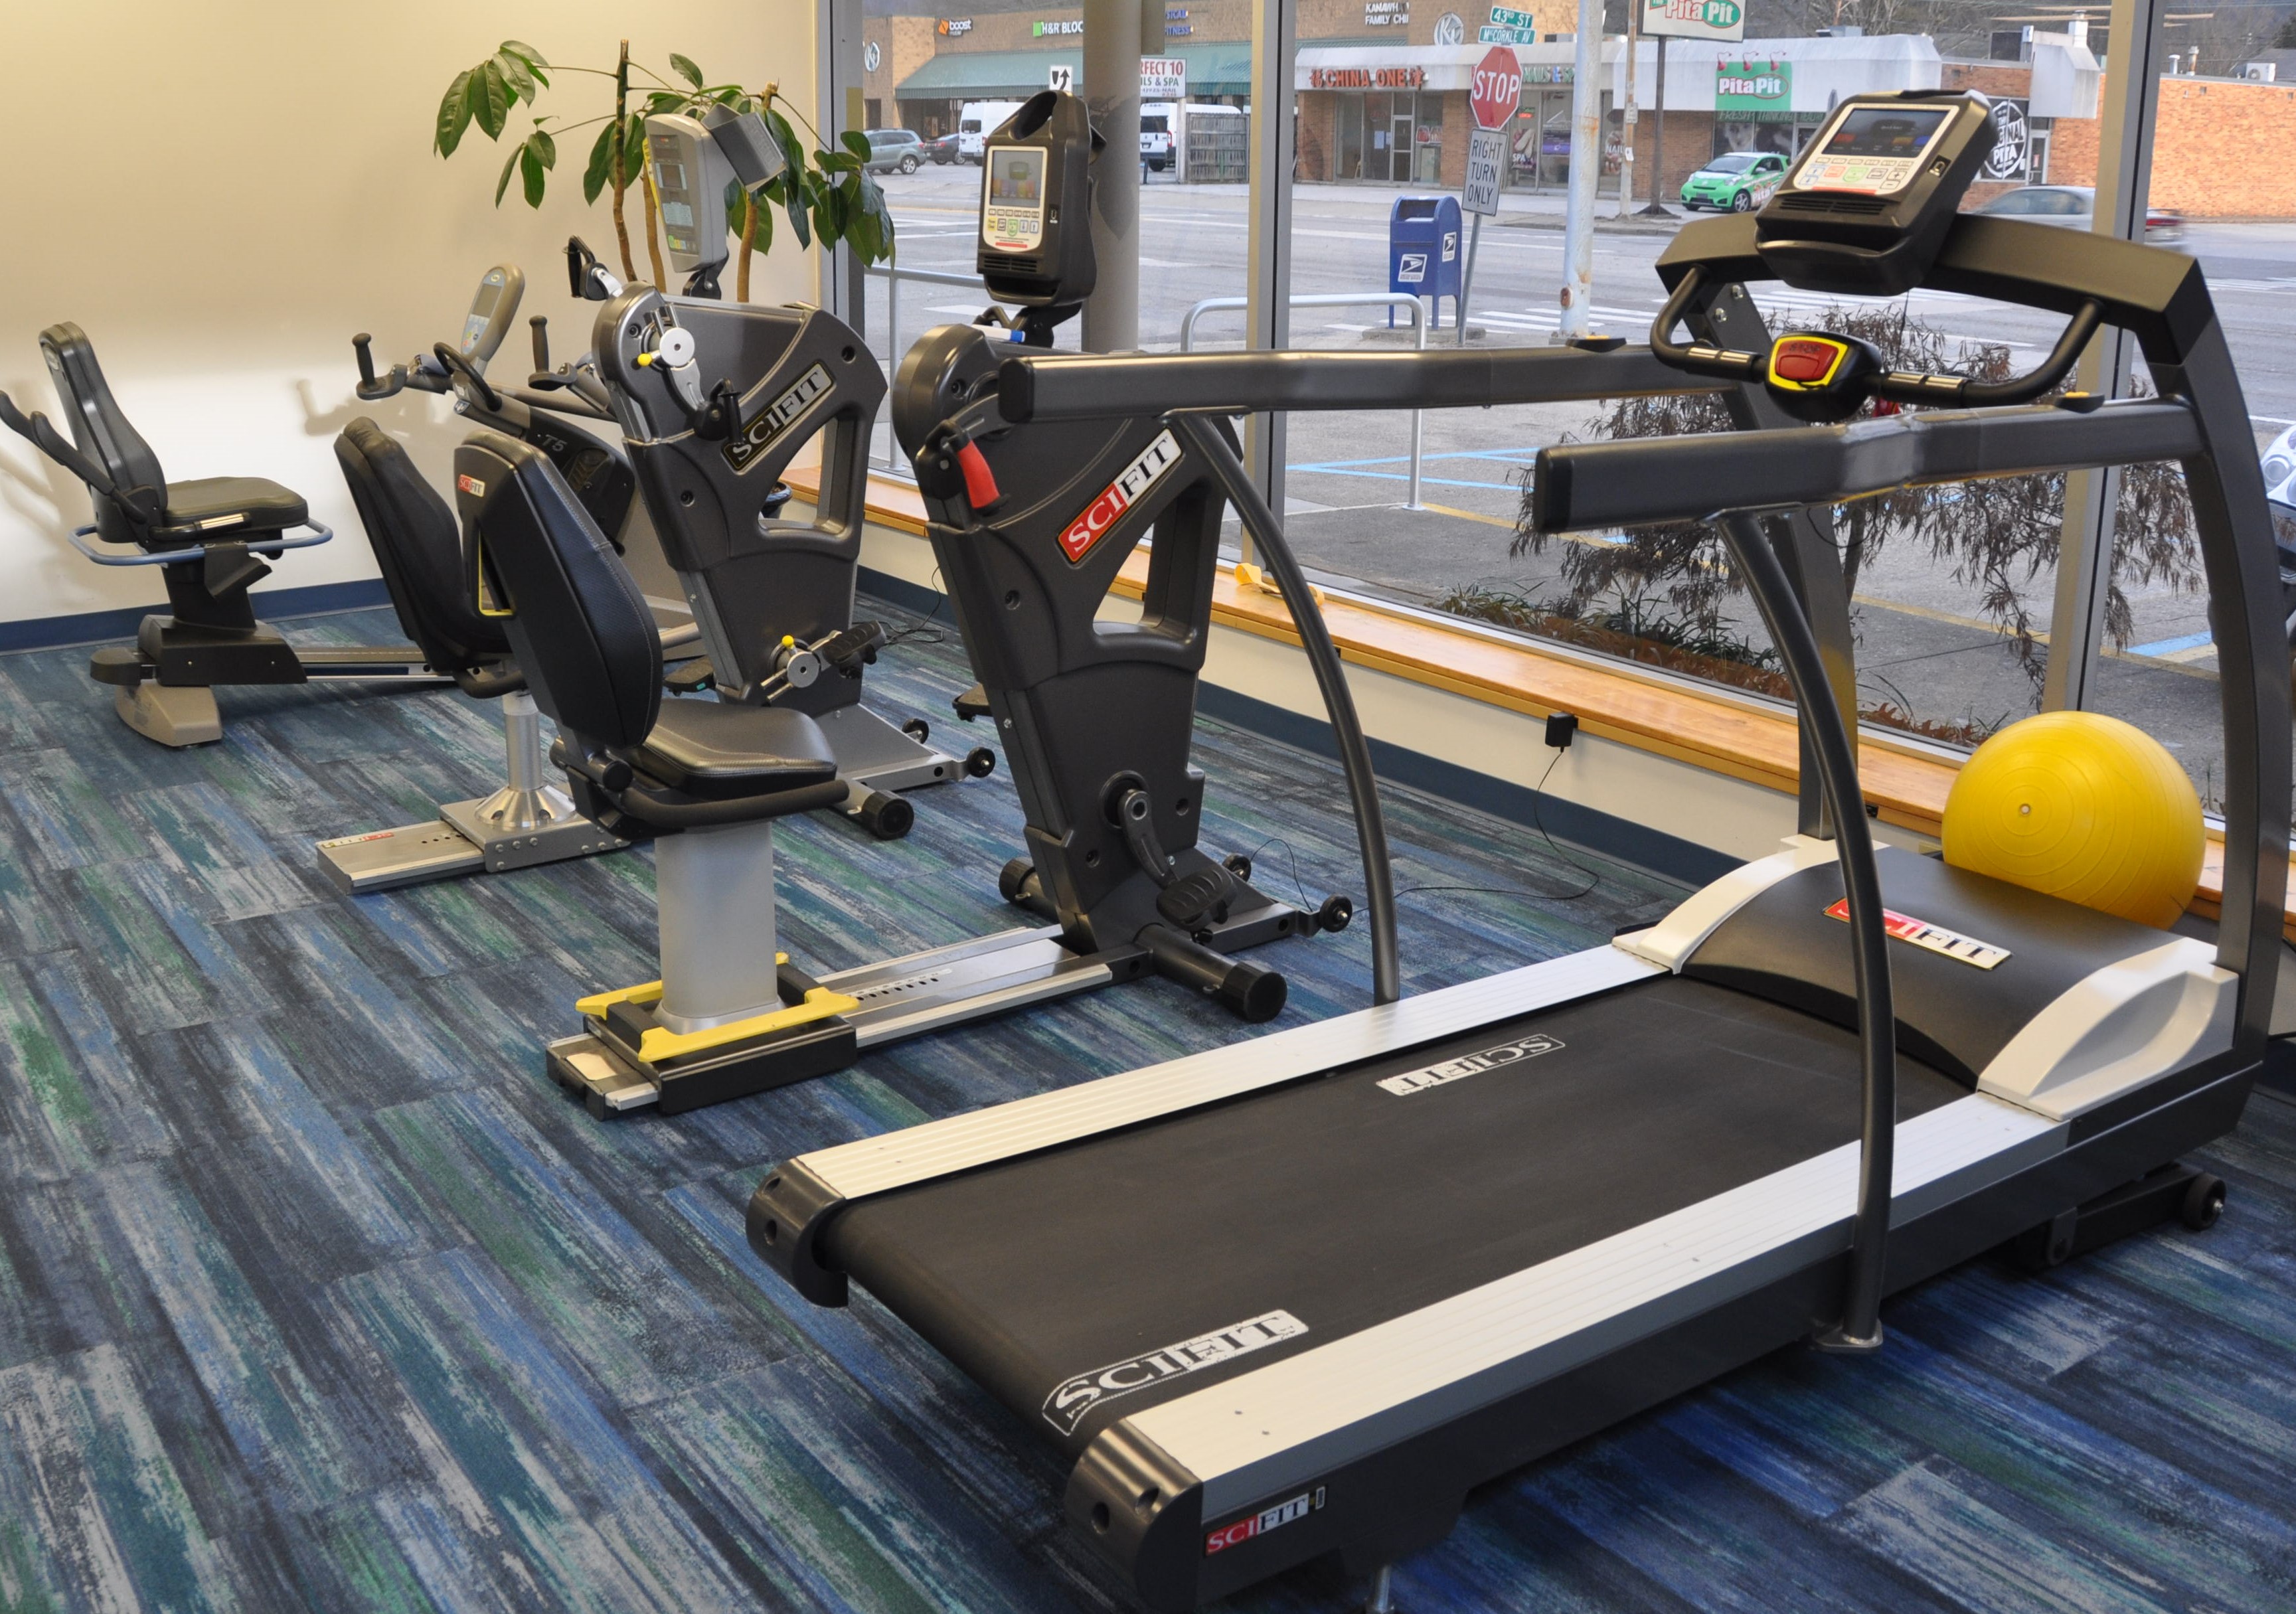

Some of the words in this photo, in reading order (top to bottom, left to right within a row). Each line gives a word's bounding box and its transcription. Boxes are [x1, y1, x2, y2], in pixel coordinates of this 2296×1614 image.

[1365, 15, 1390, 25] FAMILY
[1517, 13, 1530, 27] ST
[1666, 0, 1703, 20] Pita
[1707, 1, 1734, 23] Pit
[949, 19, 972, 31] boost
[1041, 21, 1060, 35] H&R
[1062, 21, 1084, 34] BLOC
[1521, 29, 1530, 43] AV
[1140, 61, 1167, 75] RFECT
[1170, 61, 1183, 76] 10
[1562, 67, 1576, 83] SP
[1141, 76, 1152, 86] ILS
[1155, 76, 1161, 86] &
[1163, 77, 1179, 86] SPA
[1326, 68, 1372, 87] CHINA
[1376, 68, 1408, 87] ONE
[1718, 77, 1754, 94] Pita
[1756, 77, 1781, 94] Pit
[1473, 70, 1520, 104] STOP
[1471, 139, 1503, 161] RIGHT
[1513, 153, 1526, 162] SPA
[1607, 144, 1623, 154] NAIL
[1993, 144, 2017, 165] PITA
[1471, 161, 1497, 183] TURN
[1468, 185, 1494, 205] ONLY
[732, 371, 821, 461] SCIFIT
[542, 434, 568, 452] T5
[1068, 436, 1170, 552] SCIFIT
[1208, 1498, 1307, 1552] SCIFIT
